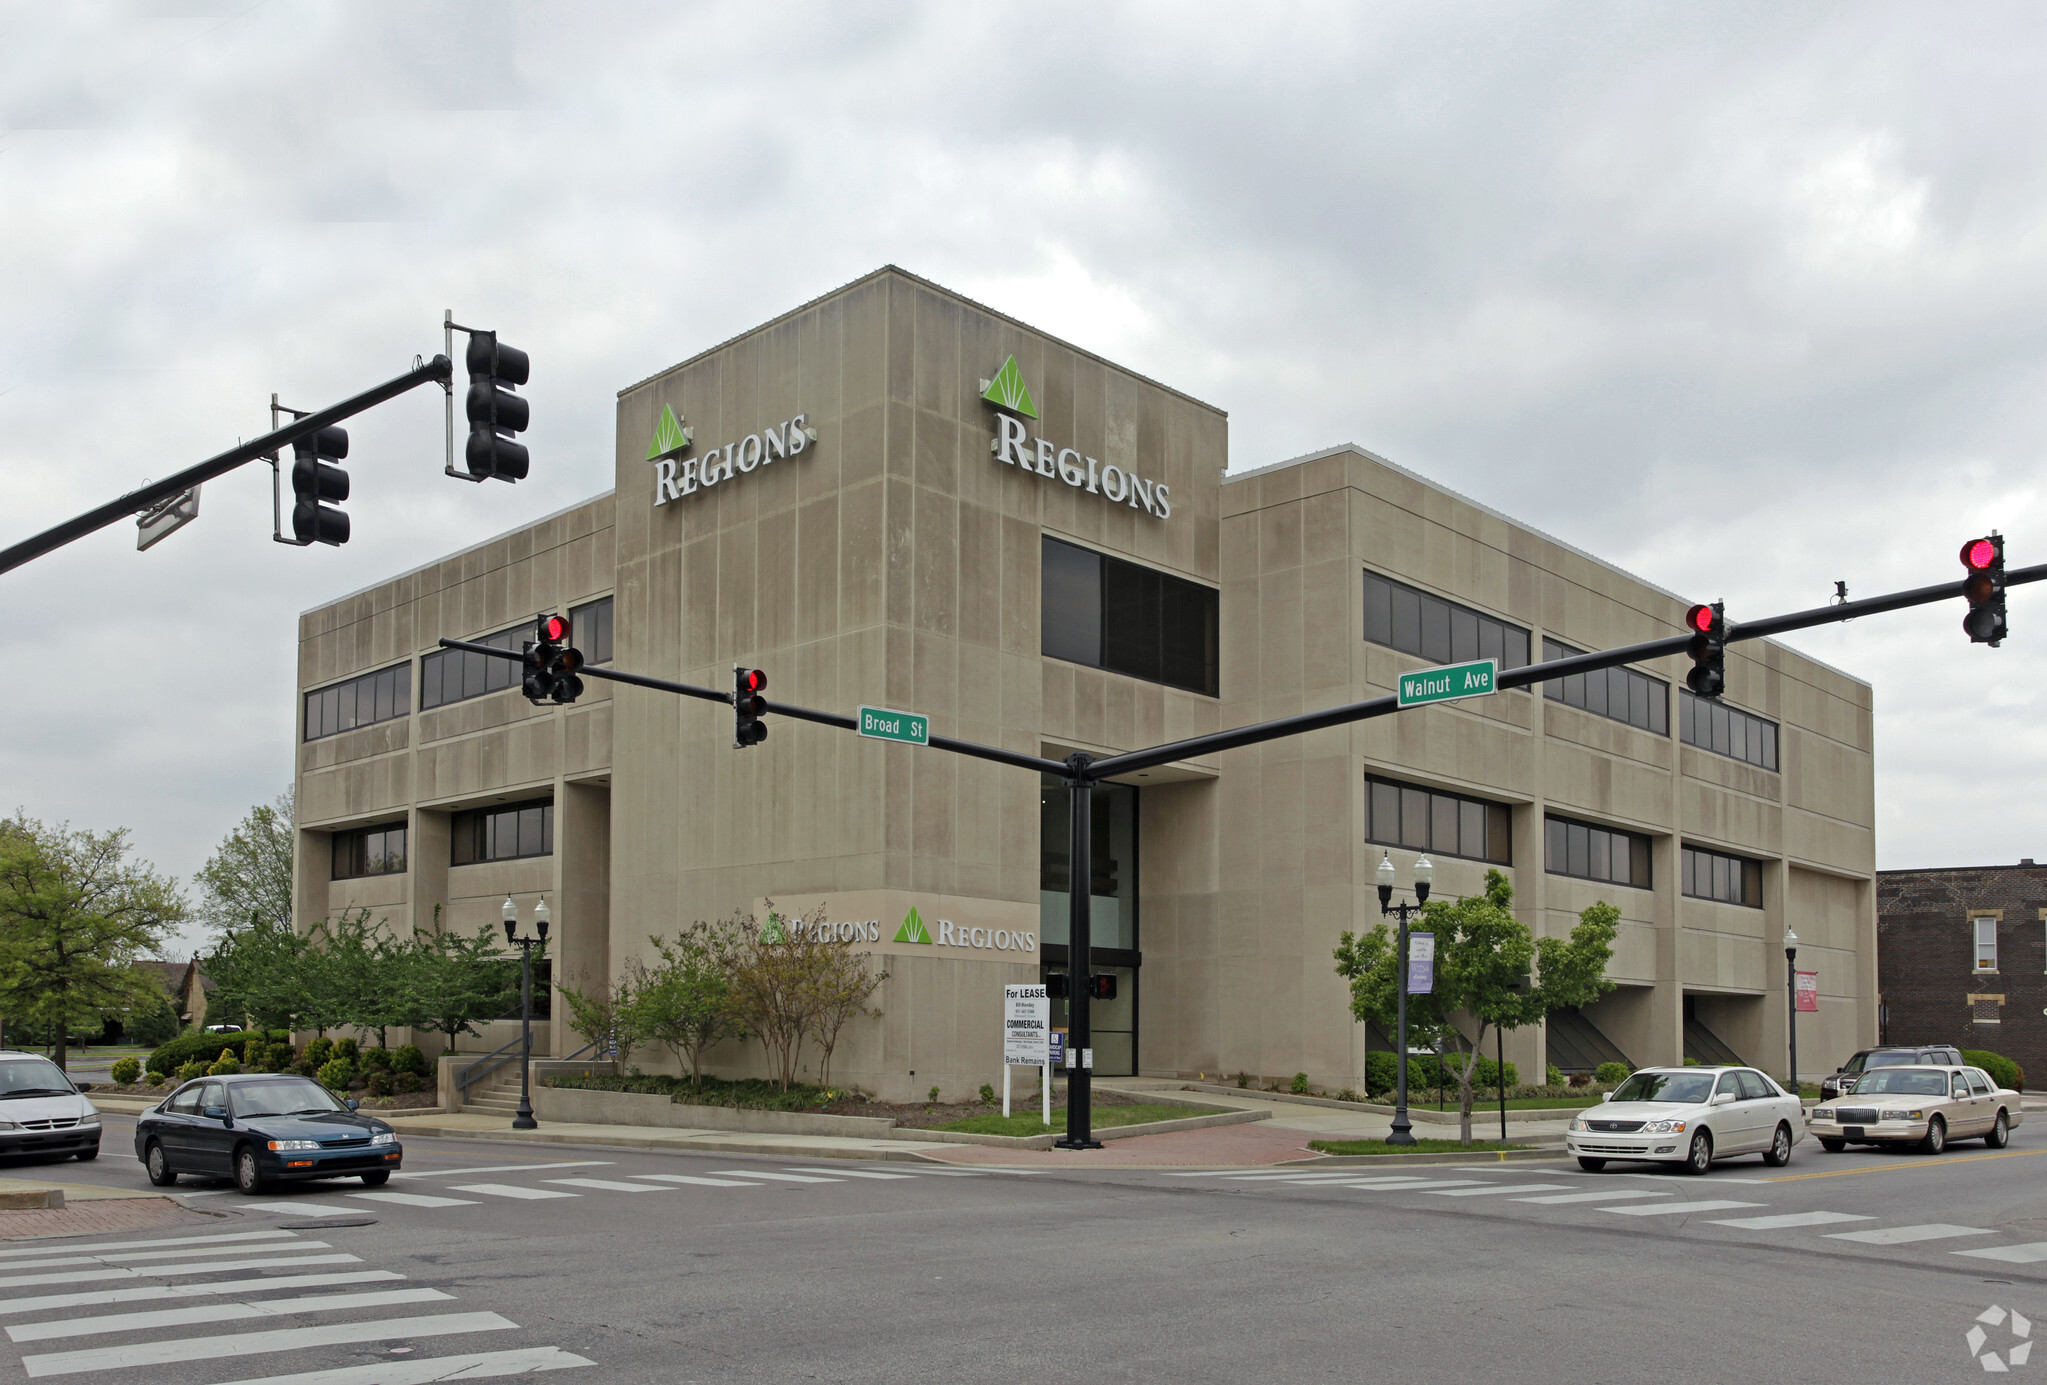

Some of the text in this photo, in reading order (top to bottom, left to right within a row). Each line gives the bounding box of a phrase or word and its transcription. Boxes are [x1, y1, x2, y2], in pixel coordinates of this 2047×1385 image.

[654, 413, 810, 507] REGIONS
[994, 412, 1171, 519] REGIONS
[1404, 671, 1489, 698] Walnut Ave
[865, 713, 923, 738] Broad St
[937, 919, 1035, 953] REGIONS
[1006, 989, 1045, 998] For LEASE
[1006, 1020, 1044, 1029] COMMERCIAL
[1006, 1056, 1020, 1064] Bank
[1021, 1057, 1045, 1065] Remains
